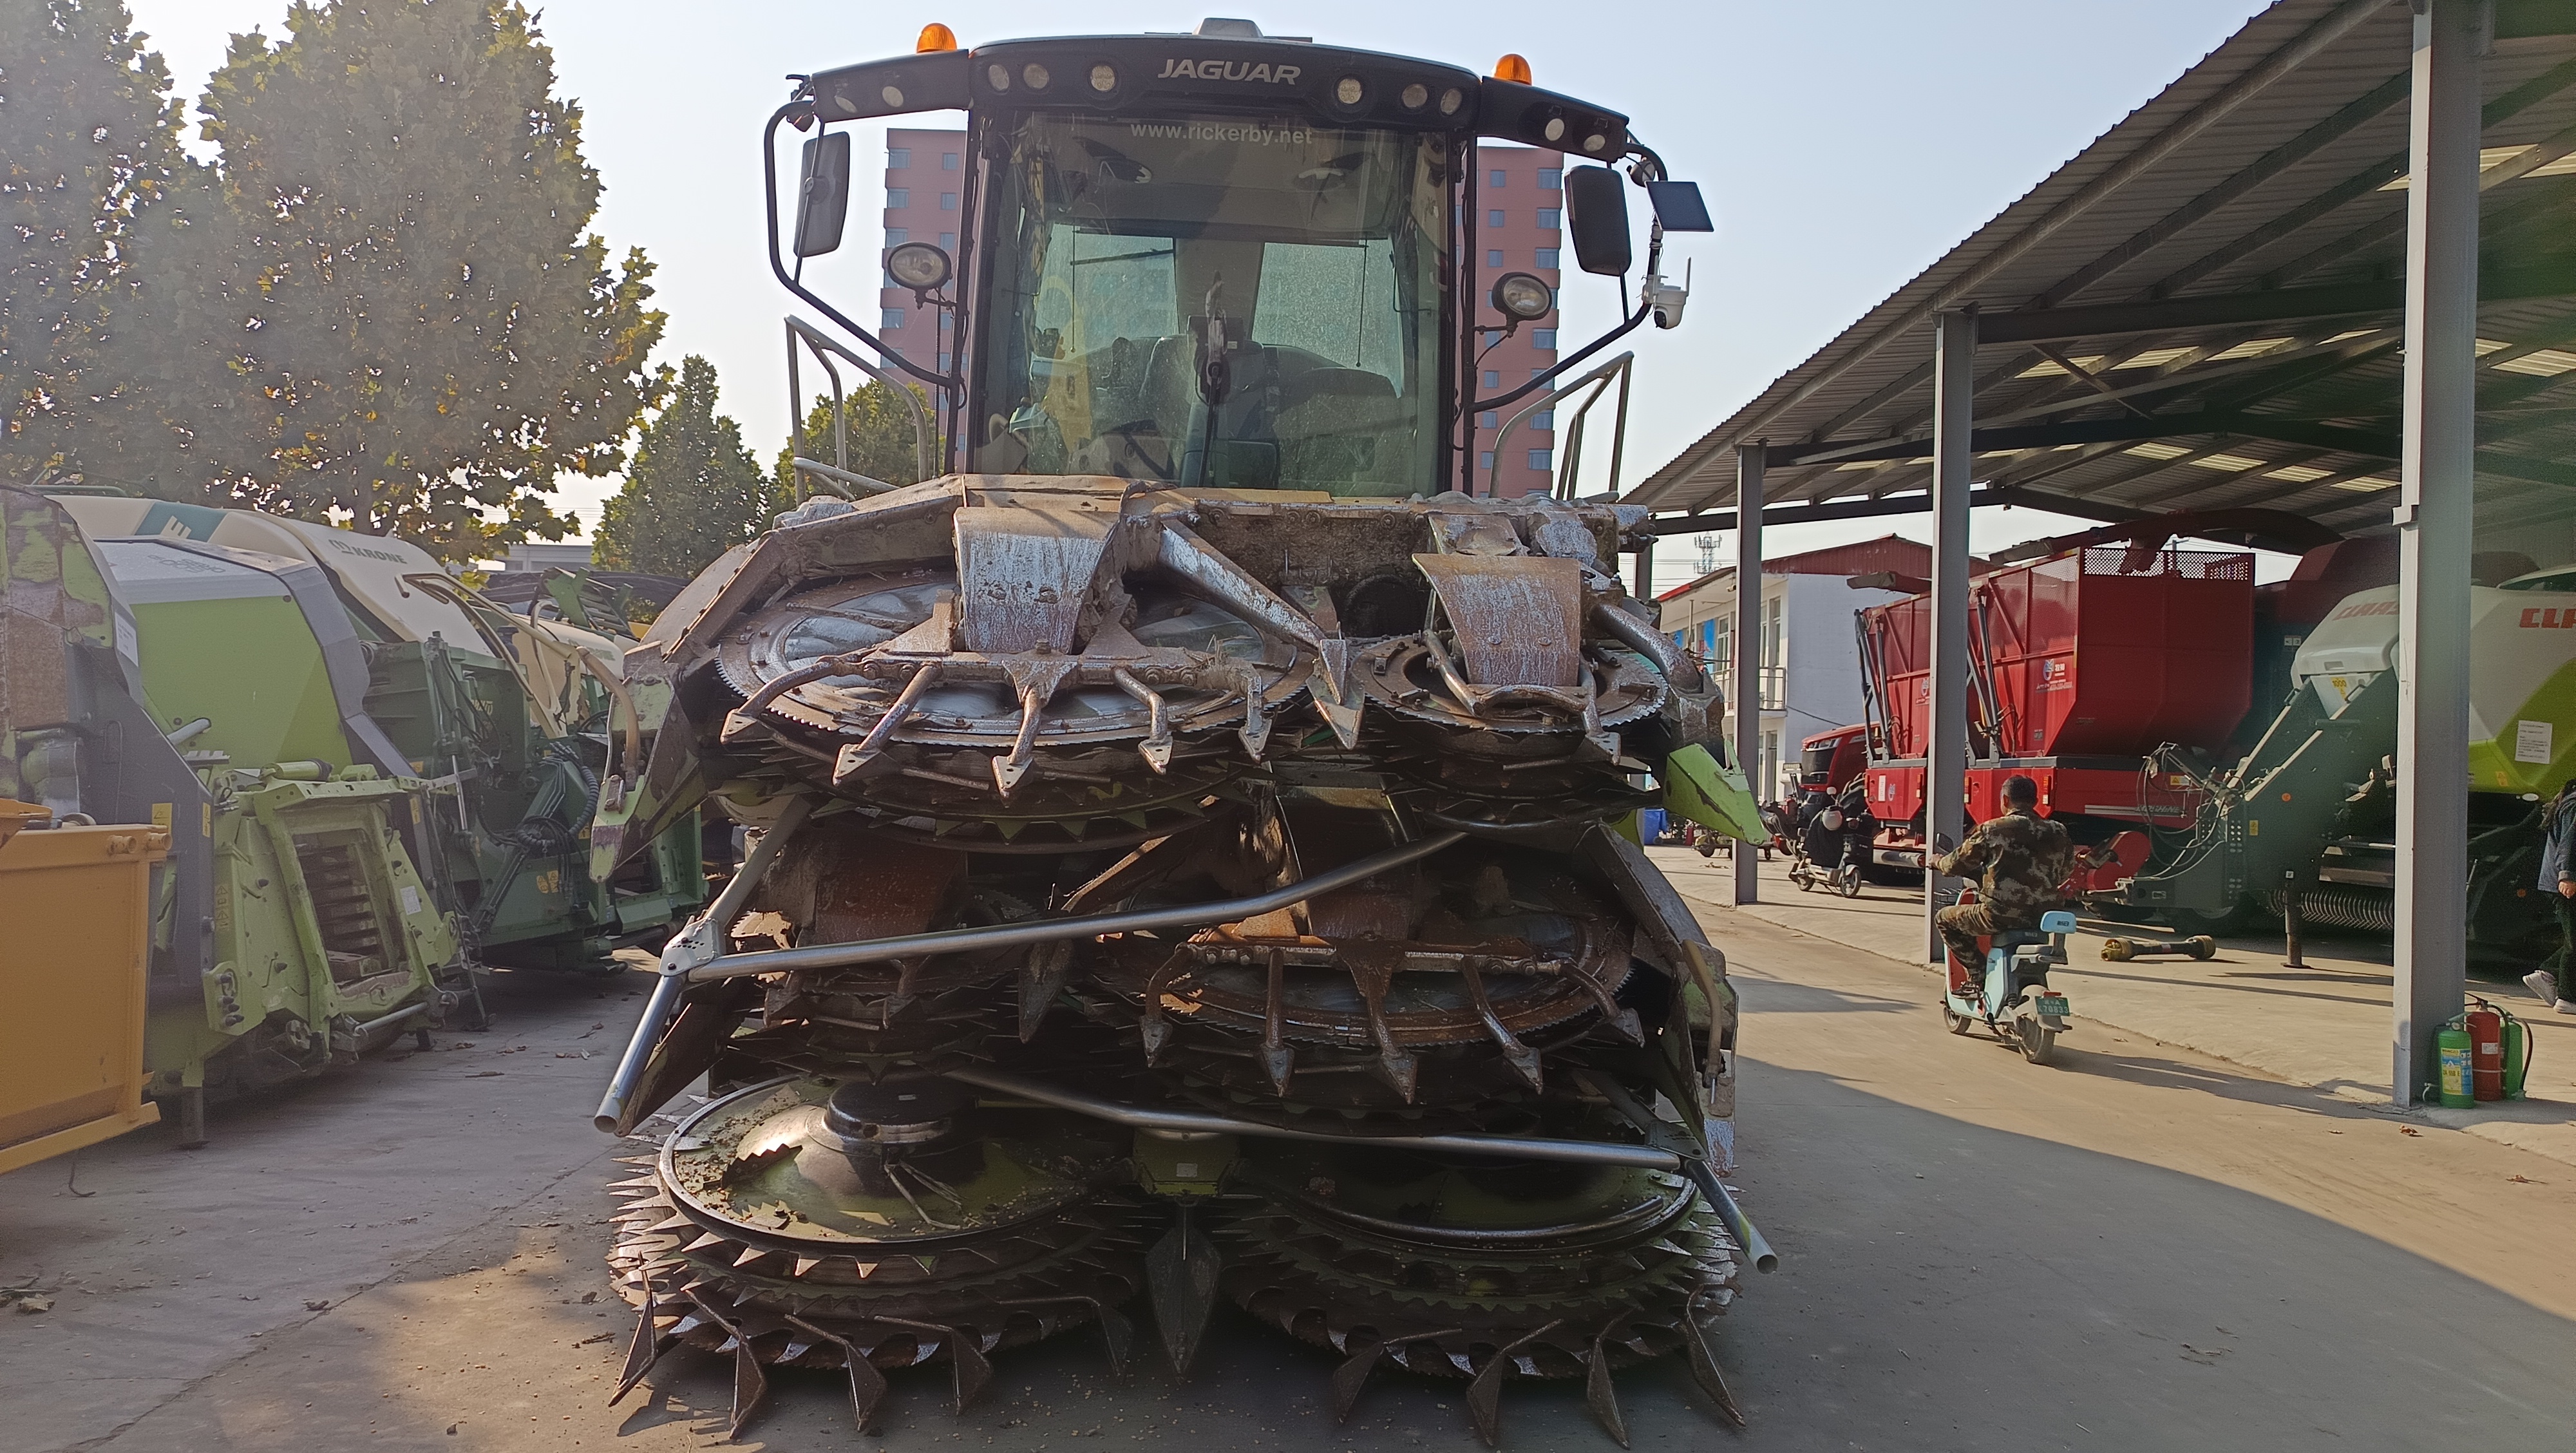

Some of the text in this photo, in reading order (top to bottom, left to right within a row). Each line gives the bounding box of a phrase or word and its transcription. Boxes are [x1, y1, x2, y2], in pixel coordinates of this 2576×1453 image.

[1158, 59, 1301, 85] JAGUAR
[1130, 123, 1312, 146] www.rickerby.net
[351, 546, 408, 564] KRONE
